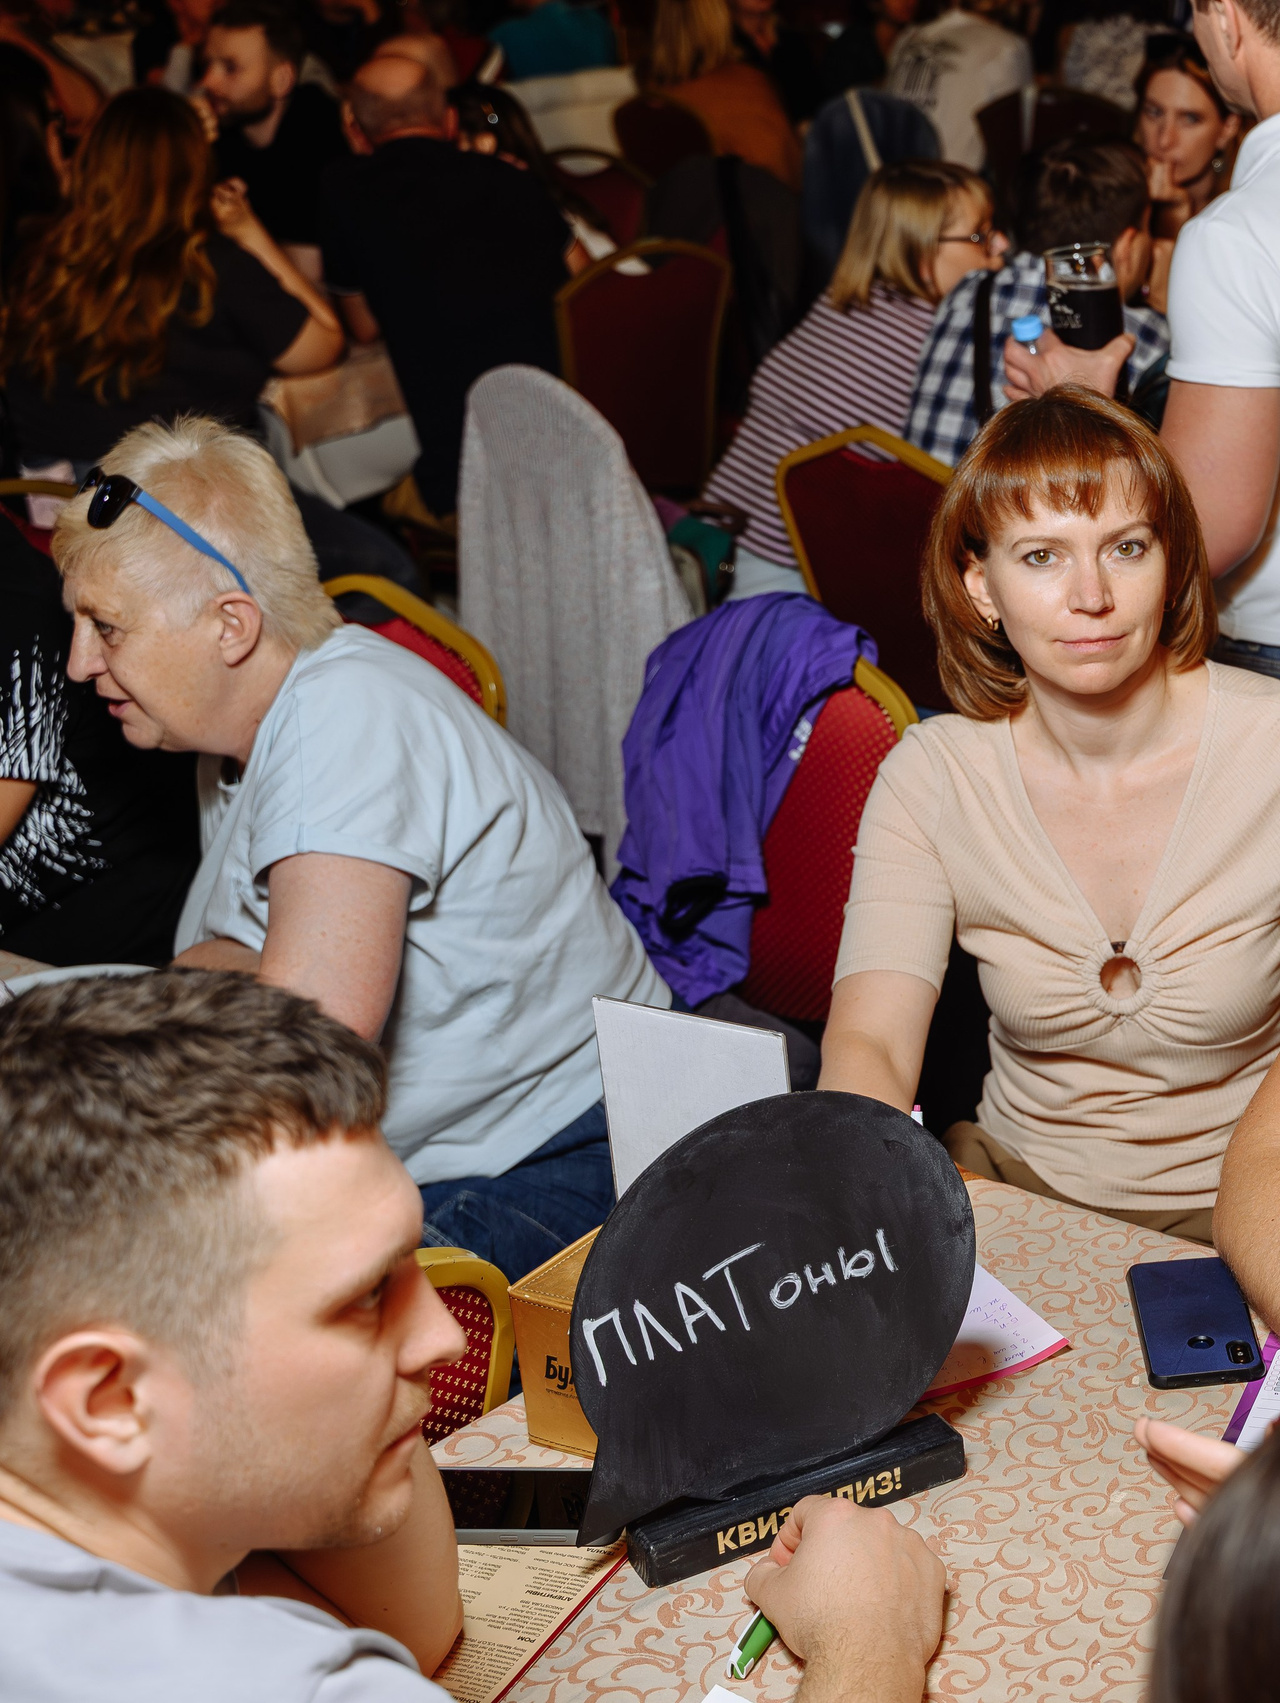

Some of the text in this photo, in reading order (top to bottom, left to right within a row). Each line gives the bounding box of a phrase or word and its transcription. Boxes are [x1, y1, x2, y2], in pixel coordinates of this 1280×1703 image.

[582, 1228, 898, 1387] ПЛАТоны
[545, 1355, 574, 1390] Бу
[821, 1466, 902, 1503] ЛИЗ!
[525, 1590, 573, 1602] АПЕРИТИВЫ
